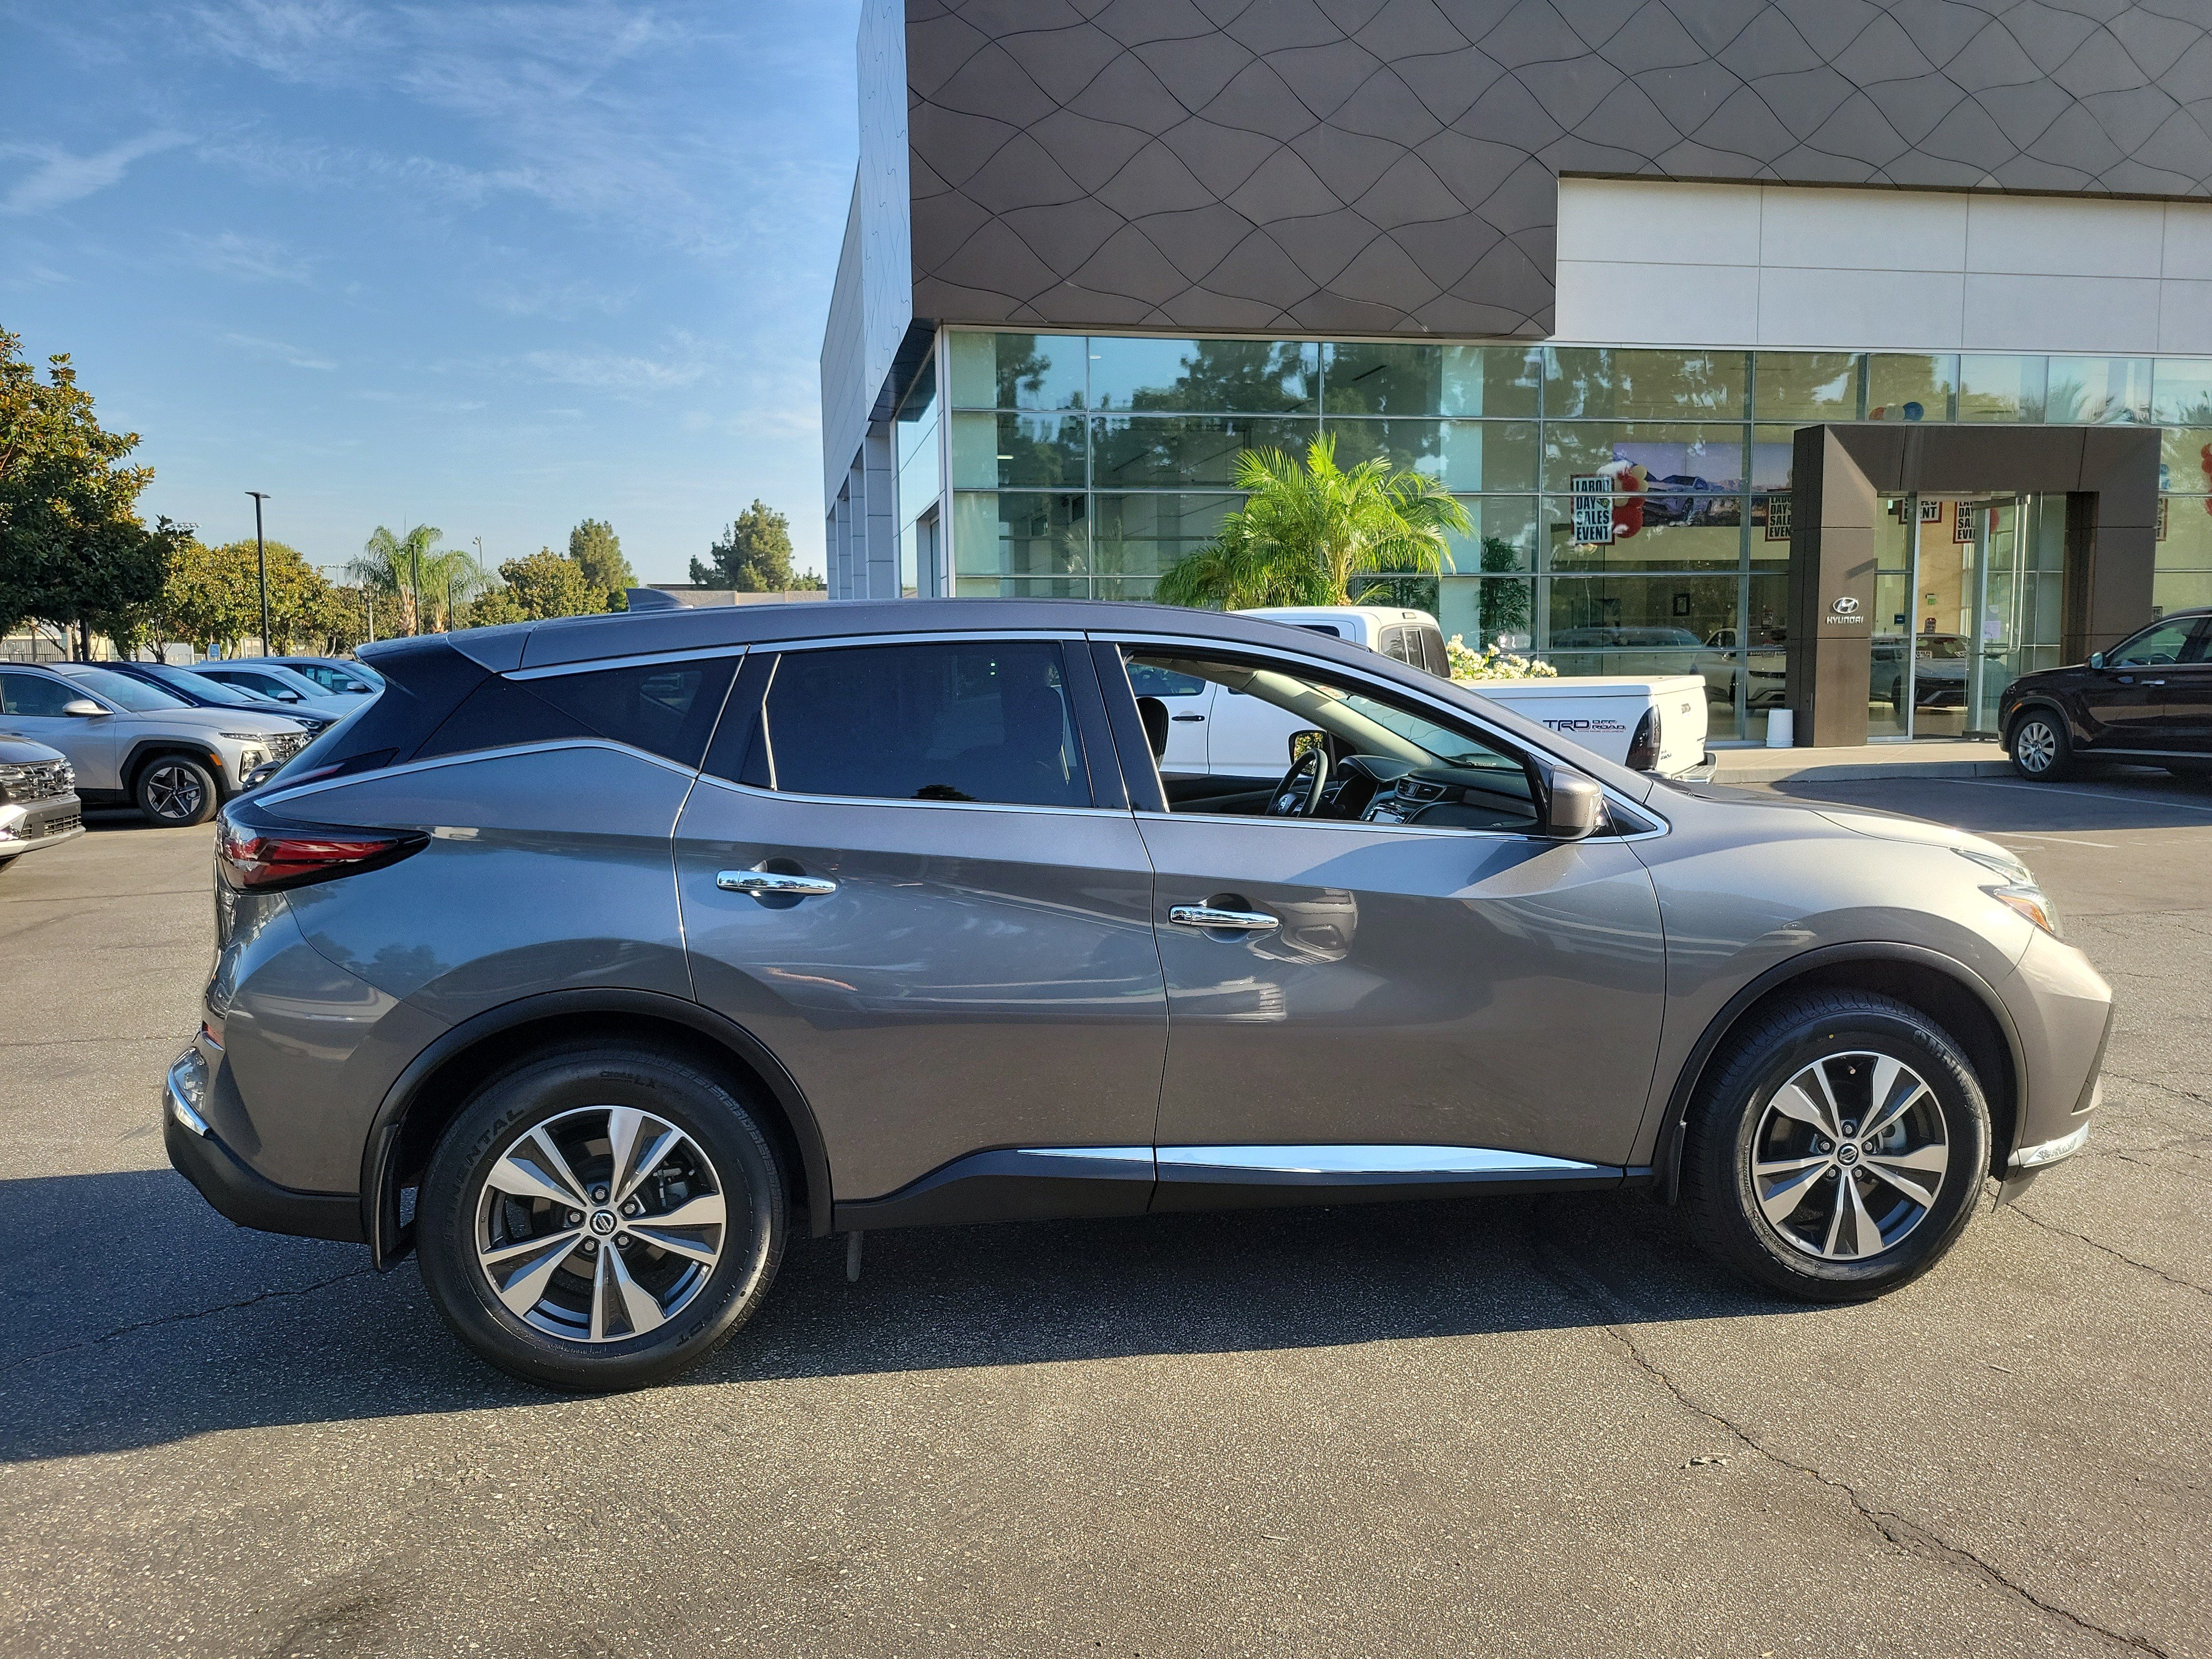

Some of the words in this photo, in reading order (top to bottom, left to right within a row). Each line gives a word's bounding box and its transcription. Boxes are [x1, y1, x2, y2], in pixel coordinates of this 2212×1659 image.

[1576, 479, 1610, 492] LABOR
[1576, 496, 1596, 510] DAY
[1770, 504, 1787, 515] DAY
[1576, 510, 1610, 526] SALES
[1770, 515, 1791, 526] SALE
[1958, 518, 1975, 529] SAL
[1577, 526, 1609, 541] EVENT
[1769, 526, 1791, 537] EVEN
[1826, 616, 1864, 624] HYUNDAI
[1542, 720, 1591, 732] TRD
